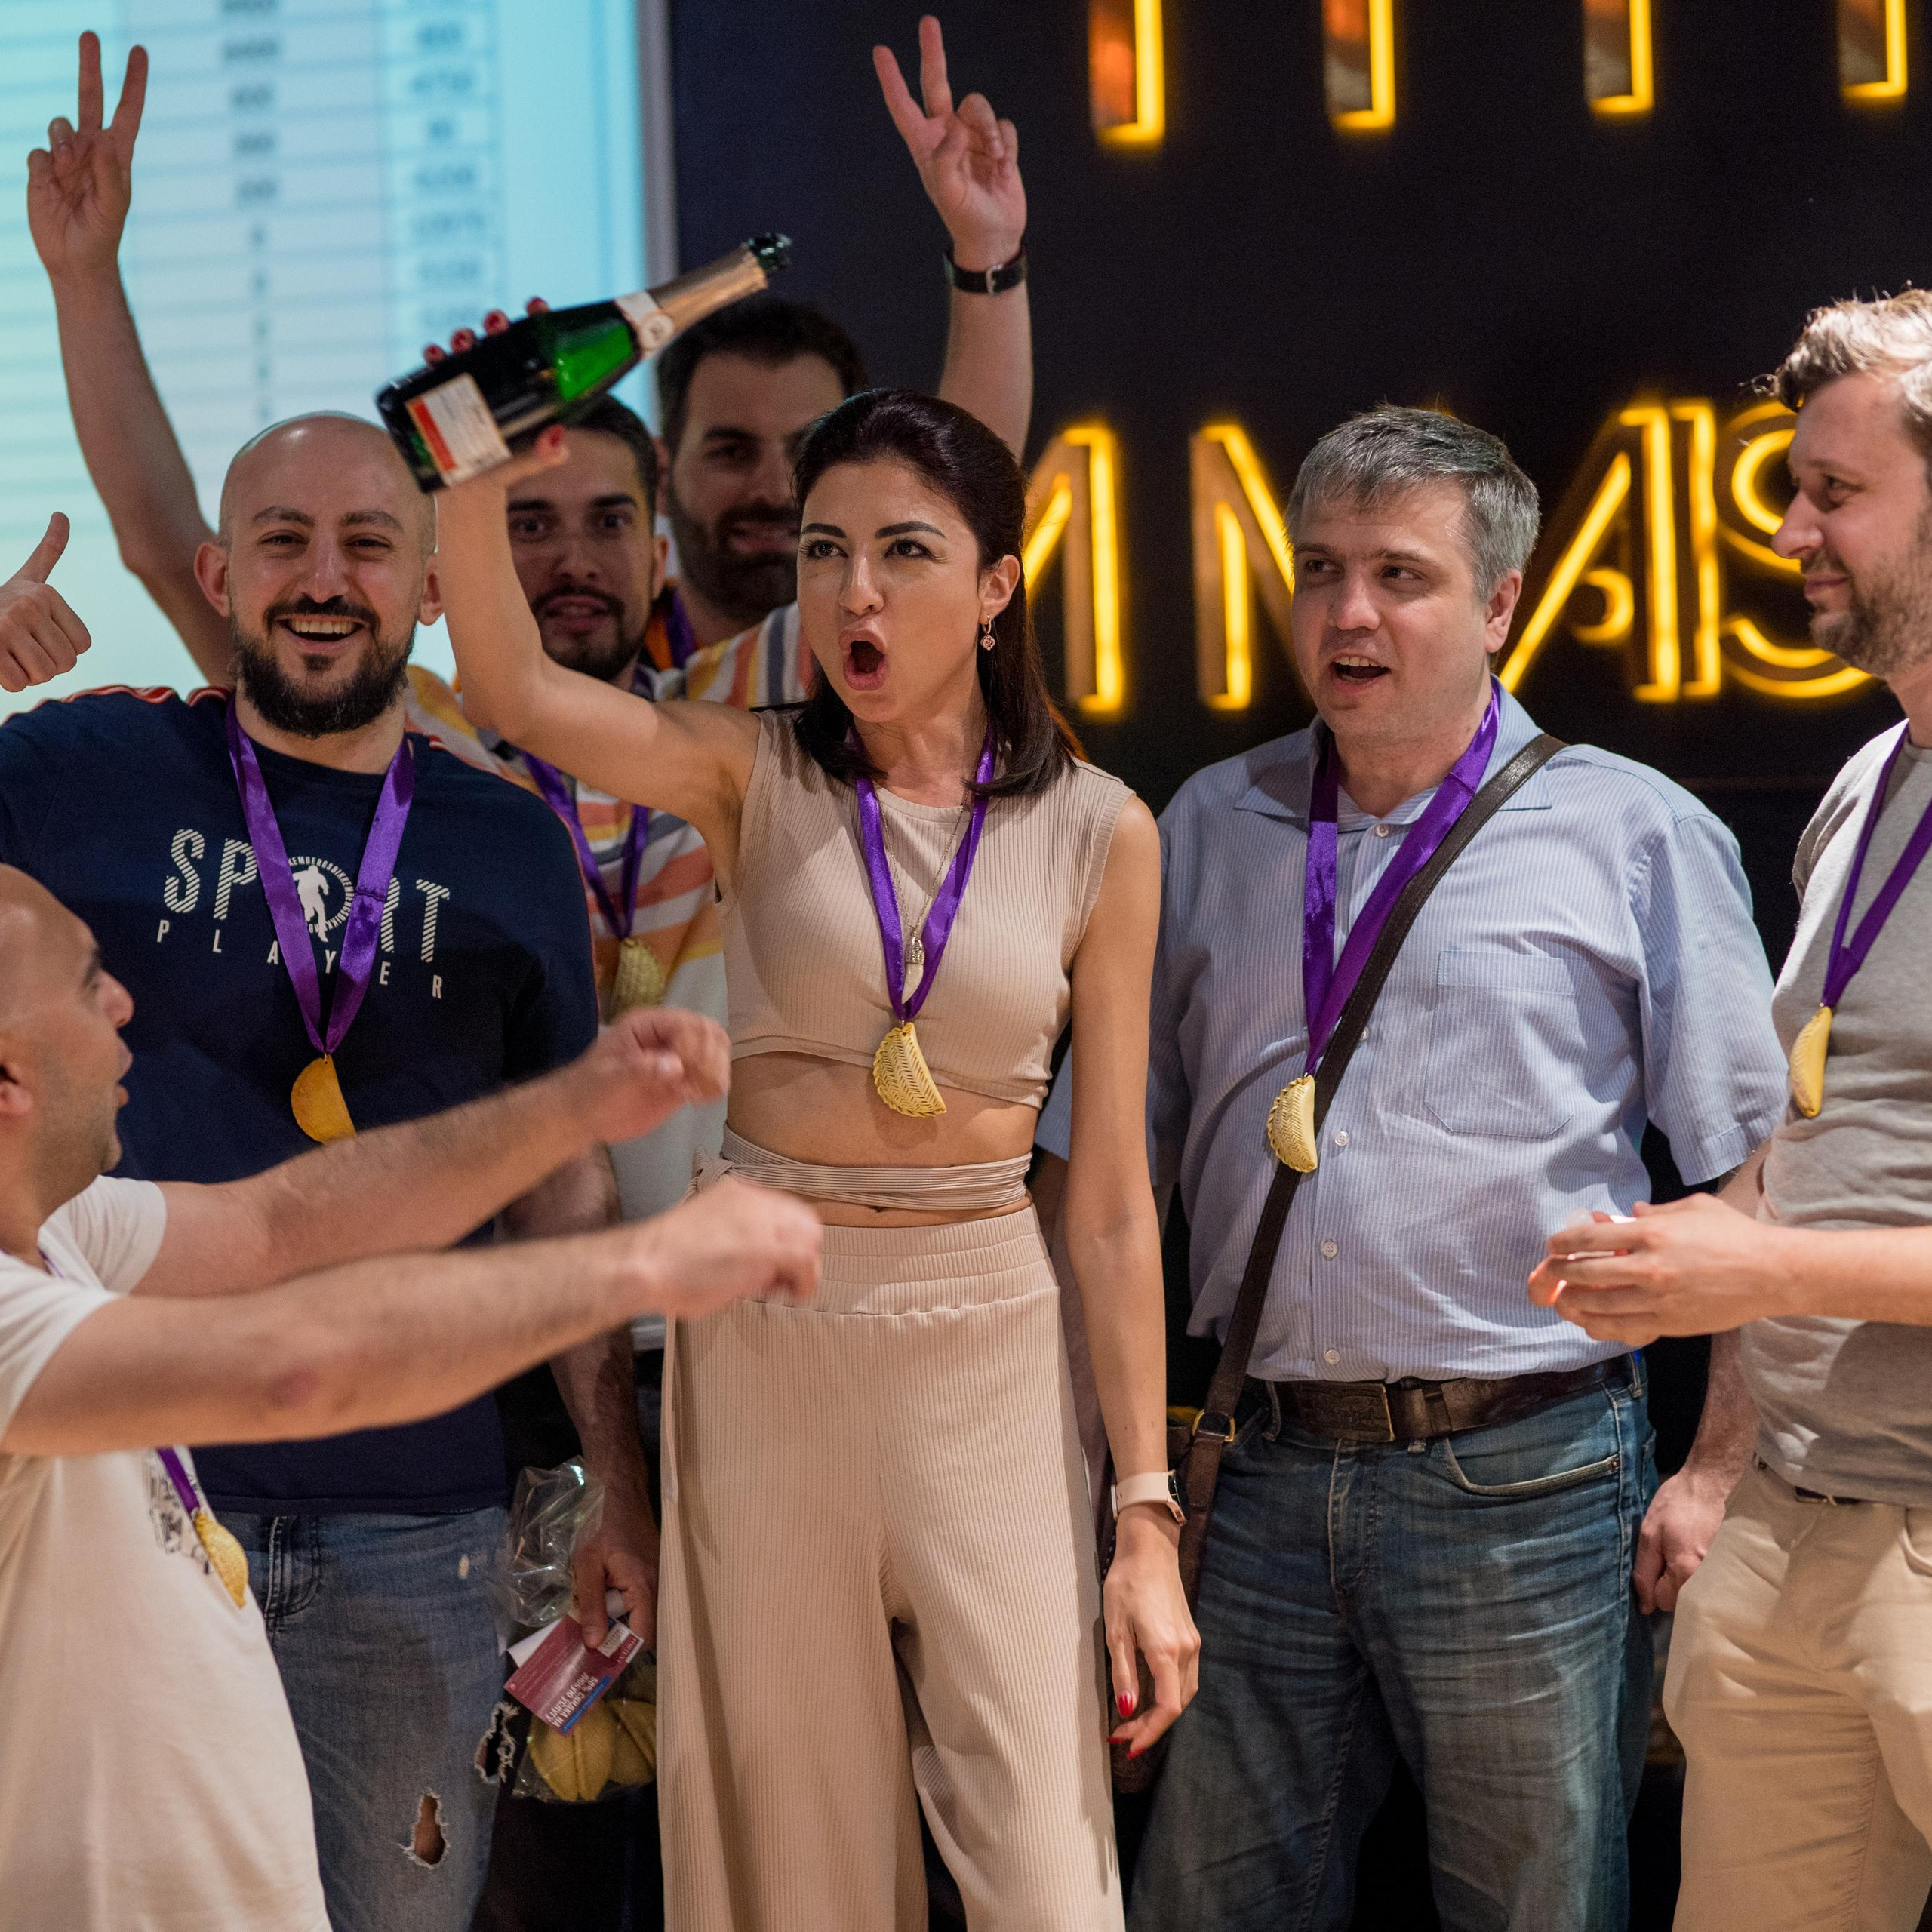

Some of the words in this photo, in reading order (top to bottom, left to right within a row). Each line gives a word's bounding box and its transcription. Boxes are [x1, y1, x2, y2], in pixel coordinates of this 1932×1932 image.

[157, 919, 443, 998] PLAYER
[565, 1672, 589, 1698] ЛЮБУЮ
[545, 1695, 568, 1722] УСЛУГУ
[561, 1690, 586, 1718] СКИДКА
[552, 1716, 565, 1727] НА
